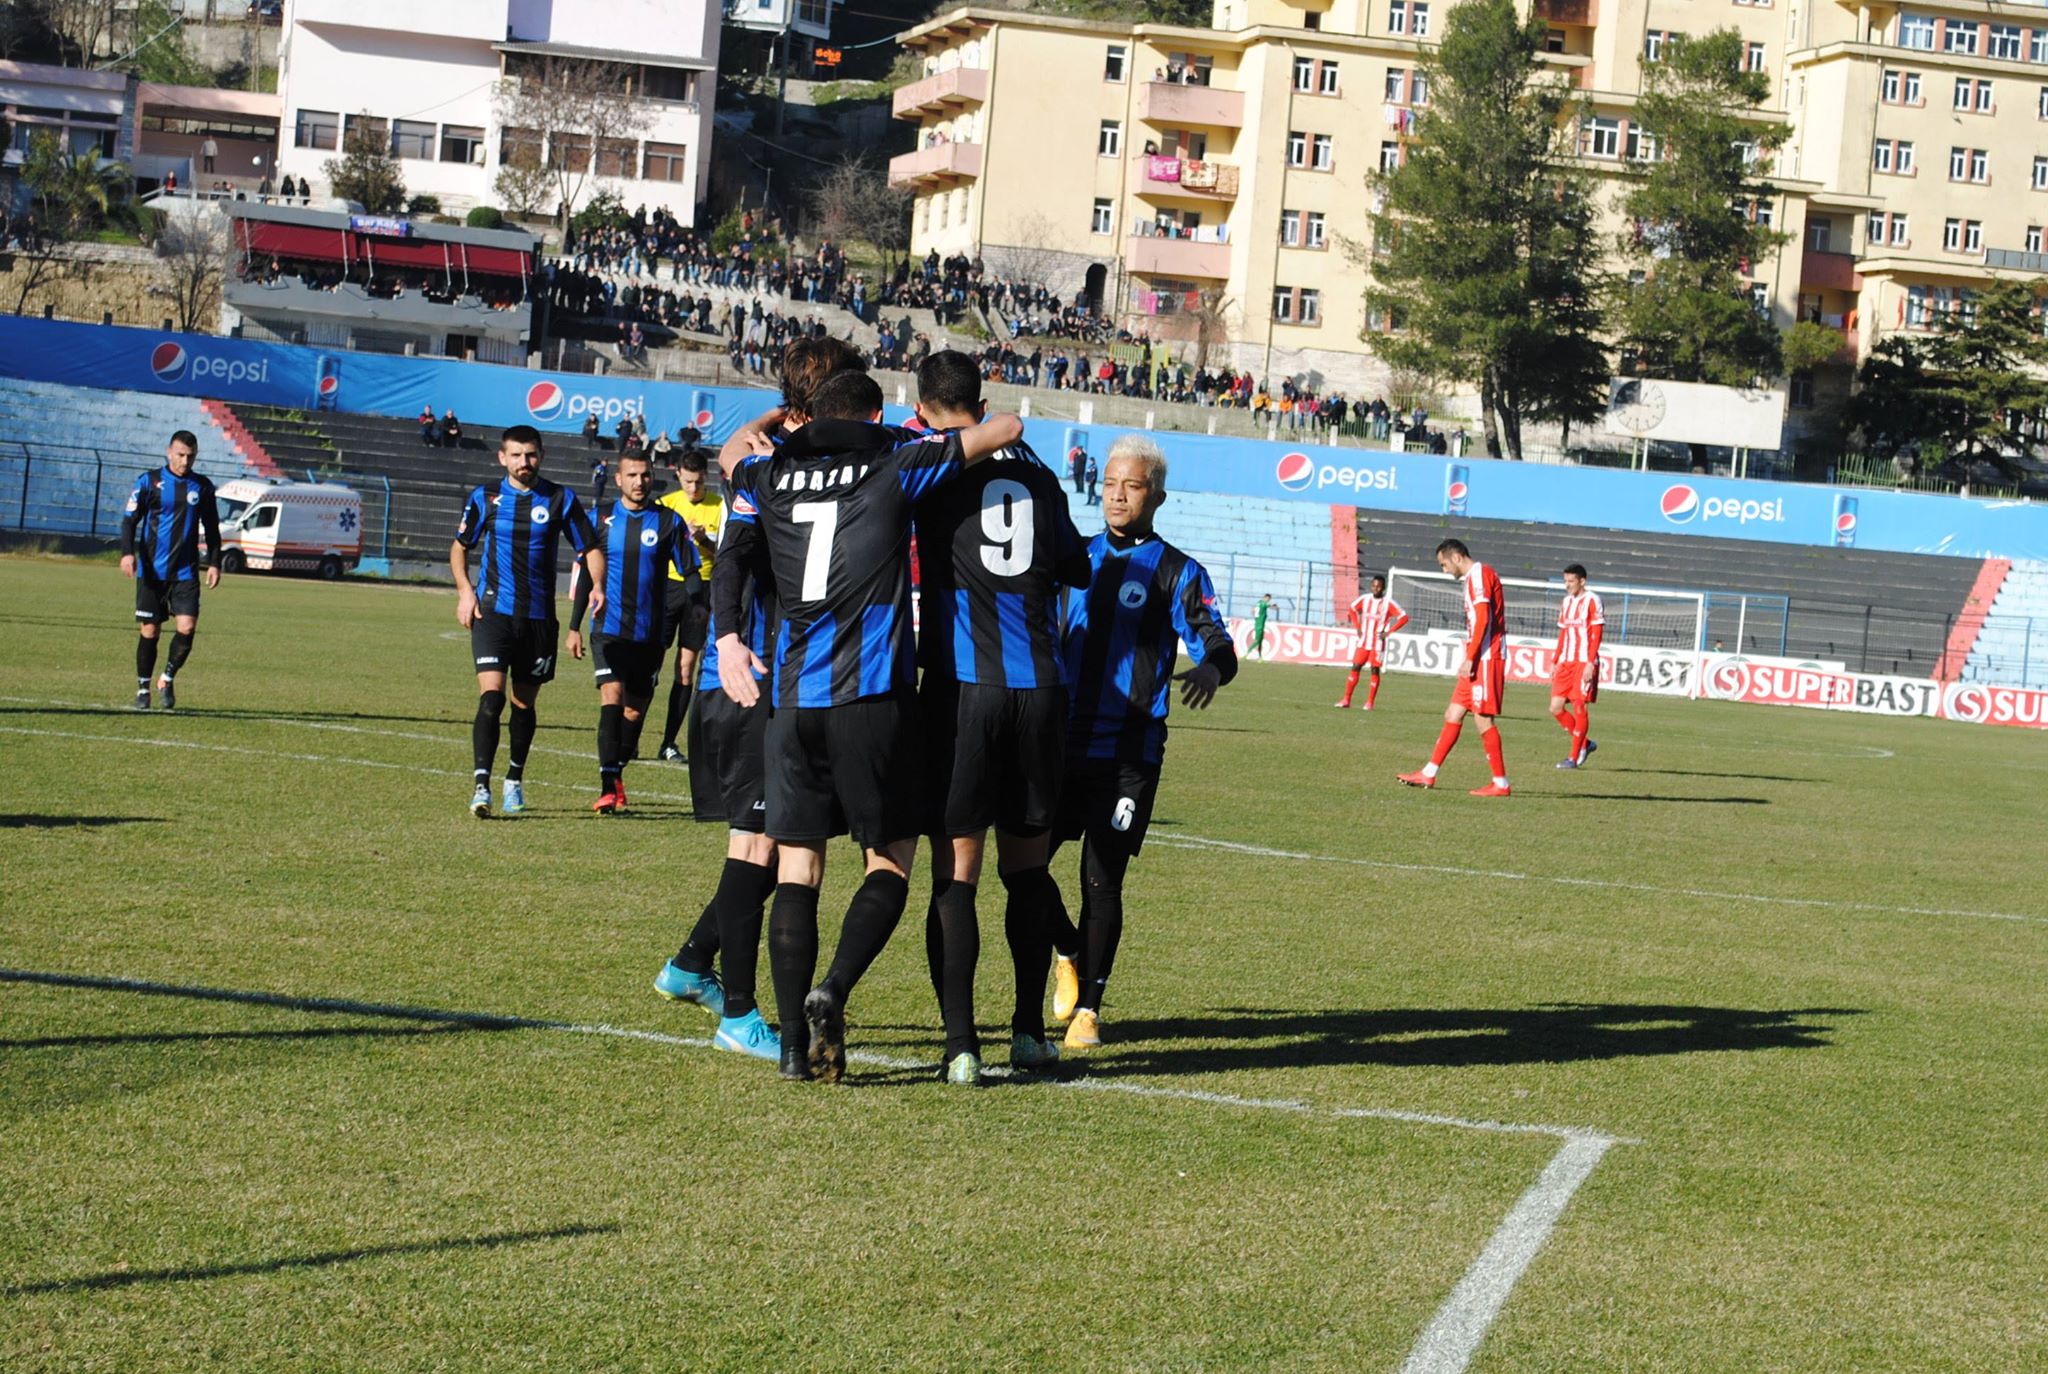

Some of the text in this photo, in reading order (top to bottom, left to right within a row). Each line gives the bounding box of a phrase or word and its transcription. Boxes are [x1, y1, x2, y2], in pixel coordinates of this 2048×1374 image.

[192, 356, 269, 385] pepsi
[568, 394, 645, 422] pepsi
[1318, 465, 1396, 492] pepsi
[1703, 497, 1783, 524] pepsi
[980, 479, 1034, 577] 9
[792, 501, 838, 602] 7
[1283, 628, 1358, 660] SUP
[1385, 637, 1459, 670] BAST
[1615, 657, 1692, 688] BAST
[1752, 667, 1851, 702] SUPER
[1856, 679, 1936, 715] BAST
[1111, 797, 1136, 831] 6
